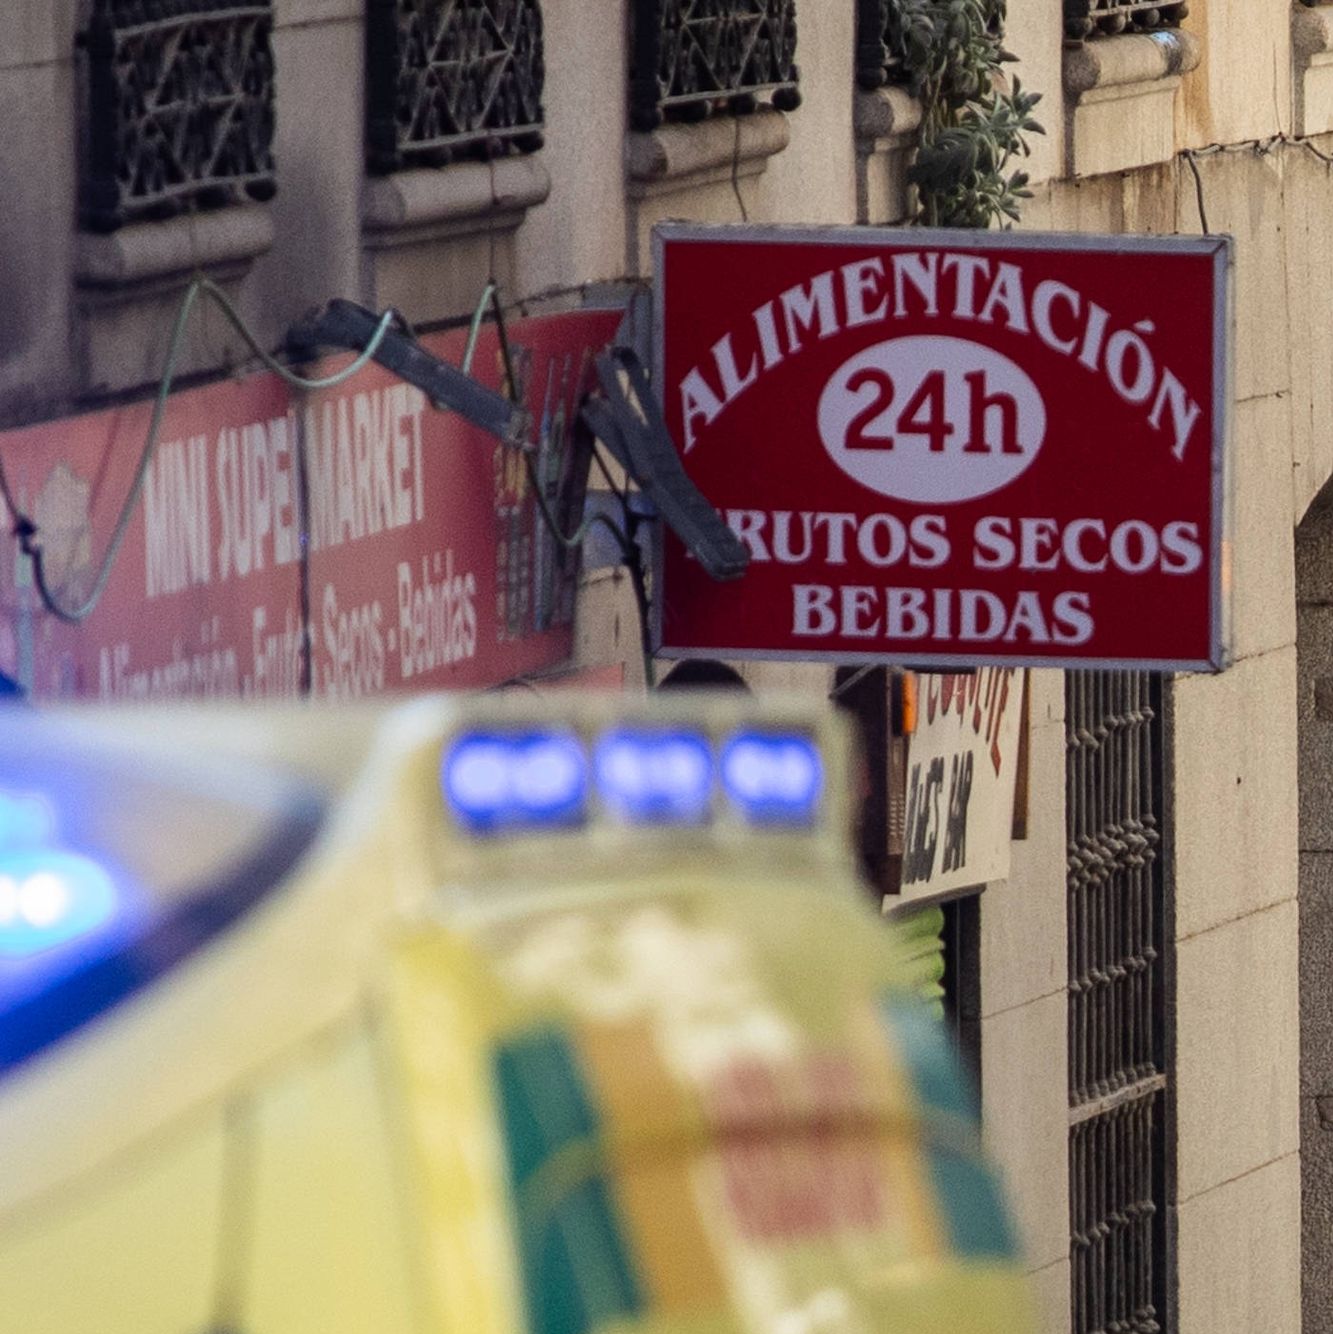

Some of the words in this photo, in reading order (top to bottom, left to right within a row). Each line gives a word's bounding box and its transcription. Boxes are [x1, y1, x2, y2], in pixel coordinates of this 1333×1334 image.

[677, 251, 1202, 461] ALIMENTACIÓN
[842, 366, 1025, 456] 24h
[690, 508, 951, 568] RUTOS
[972, 515, 1203, 575] SECOS
[790, 583, 1096, 647] BEBIDAS
